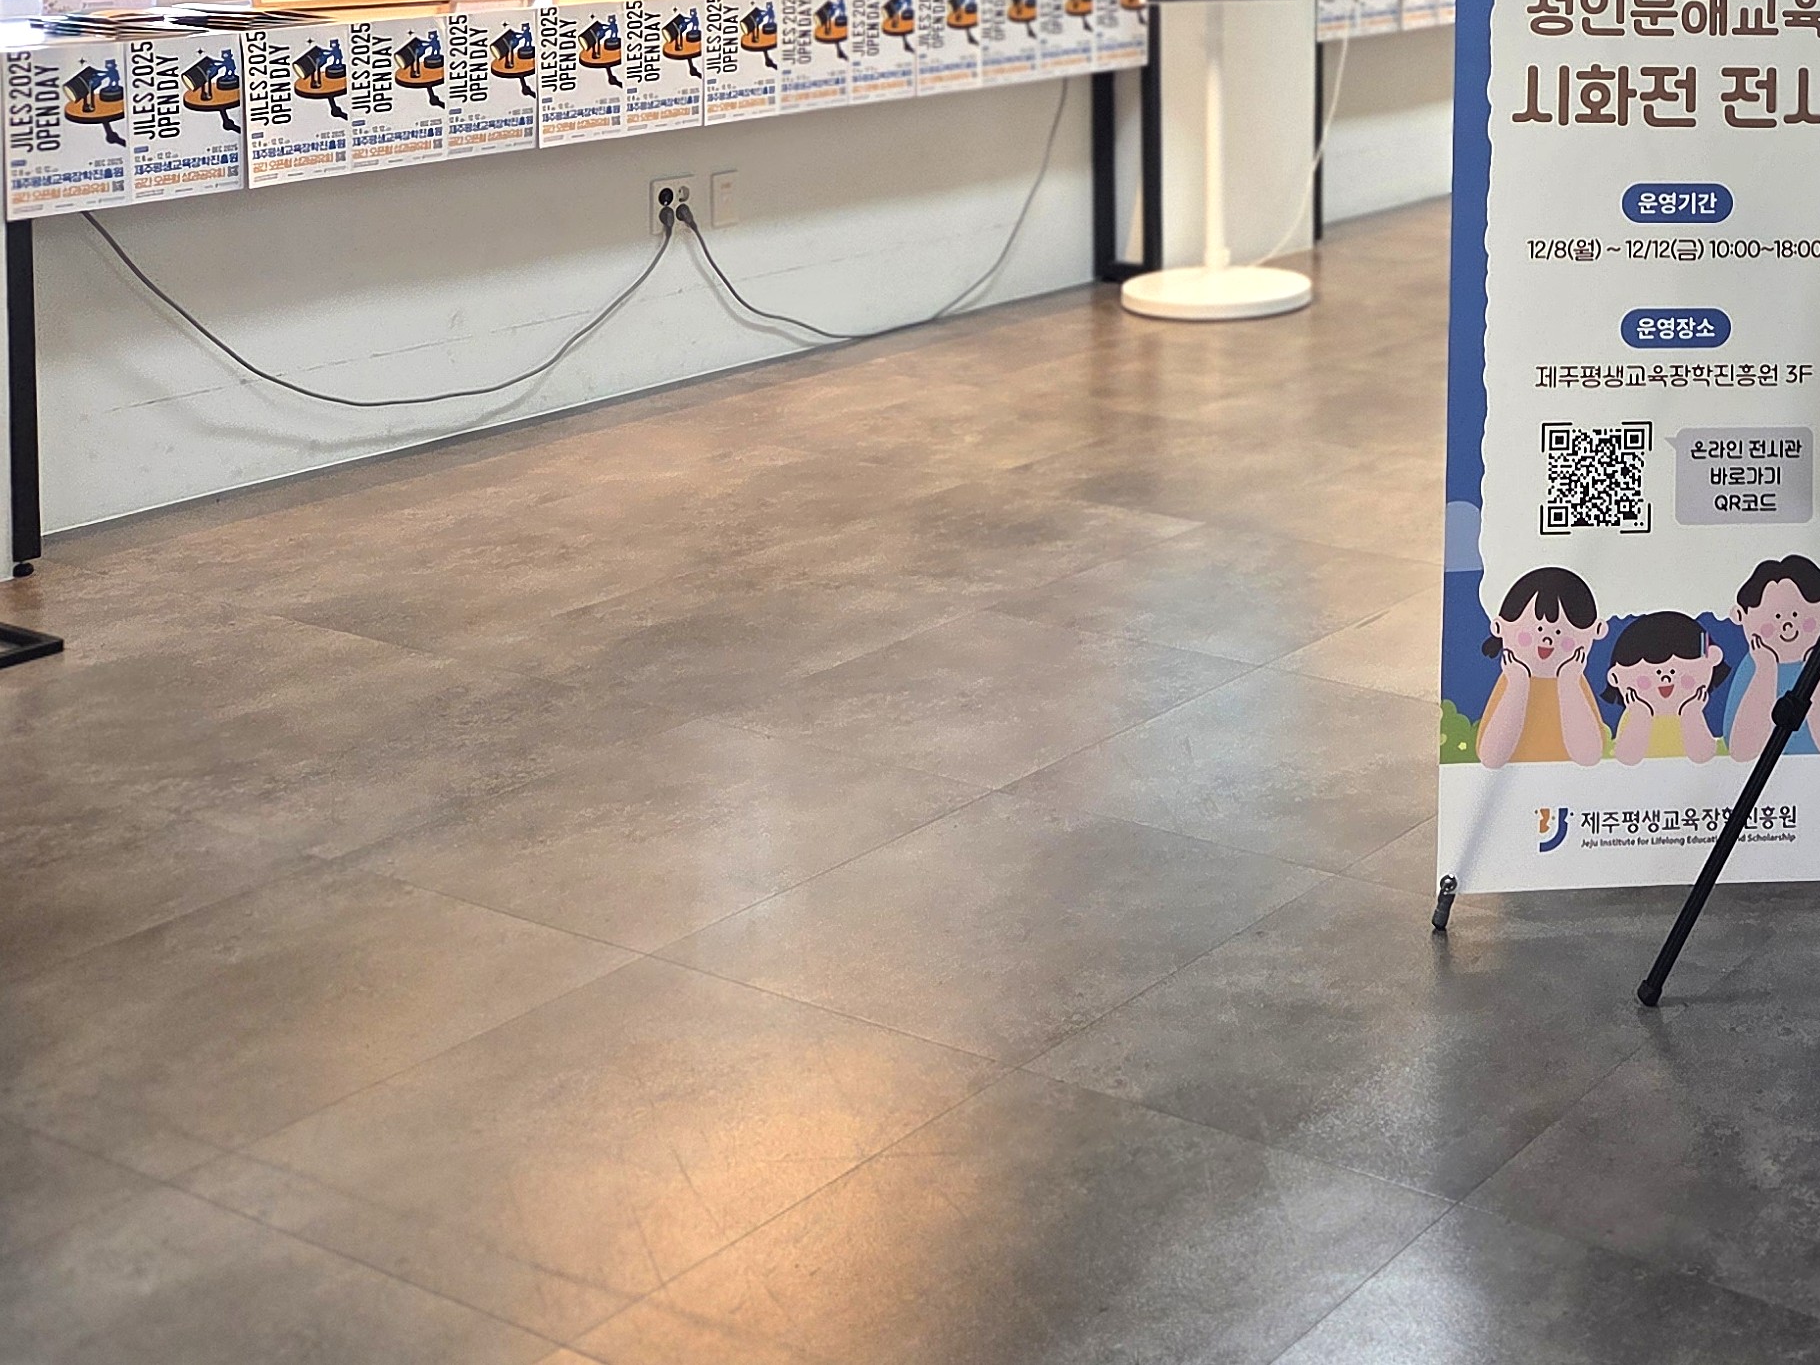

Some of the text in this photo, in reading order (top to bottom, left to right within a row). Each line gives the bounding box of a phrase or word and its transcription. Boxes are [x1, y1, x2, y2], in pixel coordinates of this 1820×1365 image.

[351, 23, 371, 114] JILES 2025
[372, 36, 393, 113] OPEN DAY
[540, 7, 558, 92] JILES 2025
[559, 19, 577, 92] OPEN DAY
[7, 51, 34, 153] JILES 2025
[34, 65, 61, 151] OPEN DAY
[131, 41, 156, 140] JILES 2025
[156, 55, 180, 138] OPEN DAY
[1511, 64, 1698, 127] 시화전
[1637, 192, 1718, 215] 운영기간
[1527, 239, 1601, 261] 12/8(월)
[1625, 239, 1705, 261] 12/12(금)
[1636, 318, 1716, 339] 운영장소
[1535, 364, 1813, 389] 제주평생교육장학진흥원 3F
[1690, 440, 1803, 459] 온라인 전시관
[1710, 467, 1782, 486] 바로가기
[1714, 494, 1777, 512] QR코드
[1600, 837, 1636, 847] Institute
[1651, 836, 1685, 847] Lifelong
[1687, 835, 1718, 844] Educati
[1747, 833, 1796, 843] Scholarship
